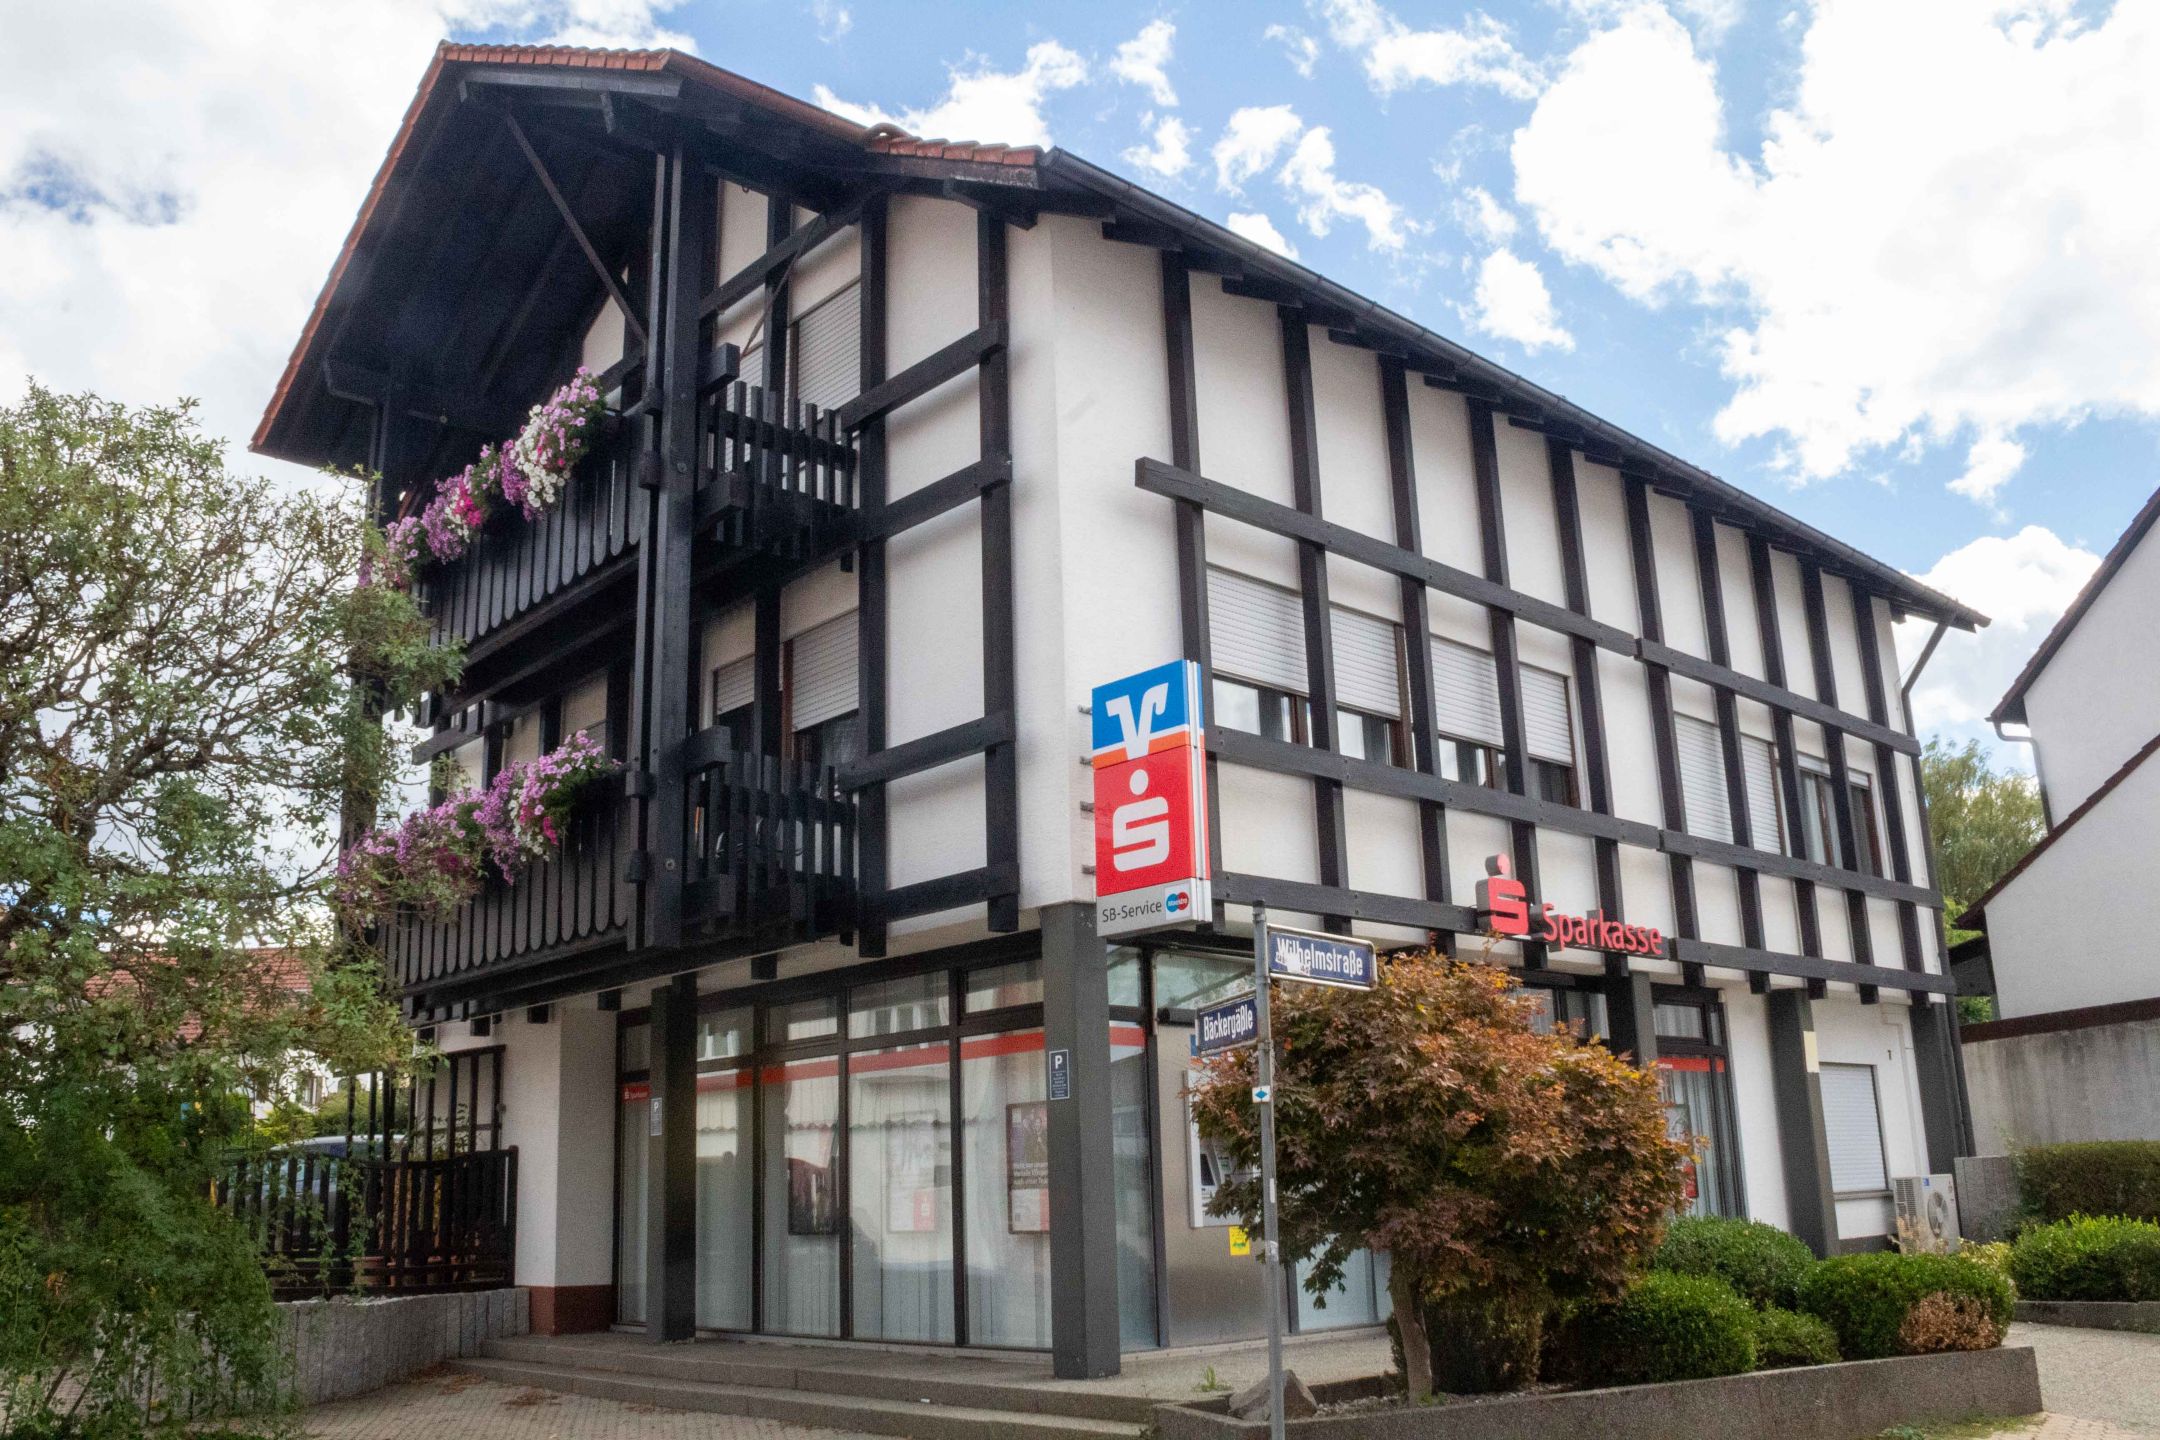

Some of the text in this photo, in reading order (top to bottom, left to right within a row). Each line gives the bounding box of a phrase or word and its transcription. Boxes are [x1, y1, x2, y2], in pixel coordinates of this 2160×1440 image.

[1102, 900, 1162, 923] SB-Service
[1542, 903, 1663, 954] Sparkasse
[1276, 937, 1364, 977] Wilhelmstraße
[1203, 1004, 1253, 1041] Bäckergäßle
[1054, 1055, 1063, 1070] P
